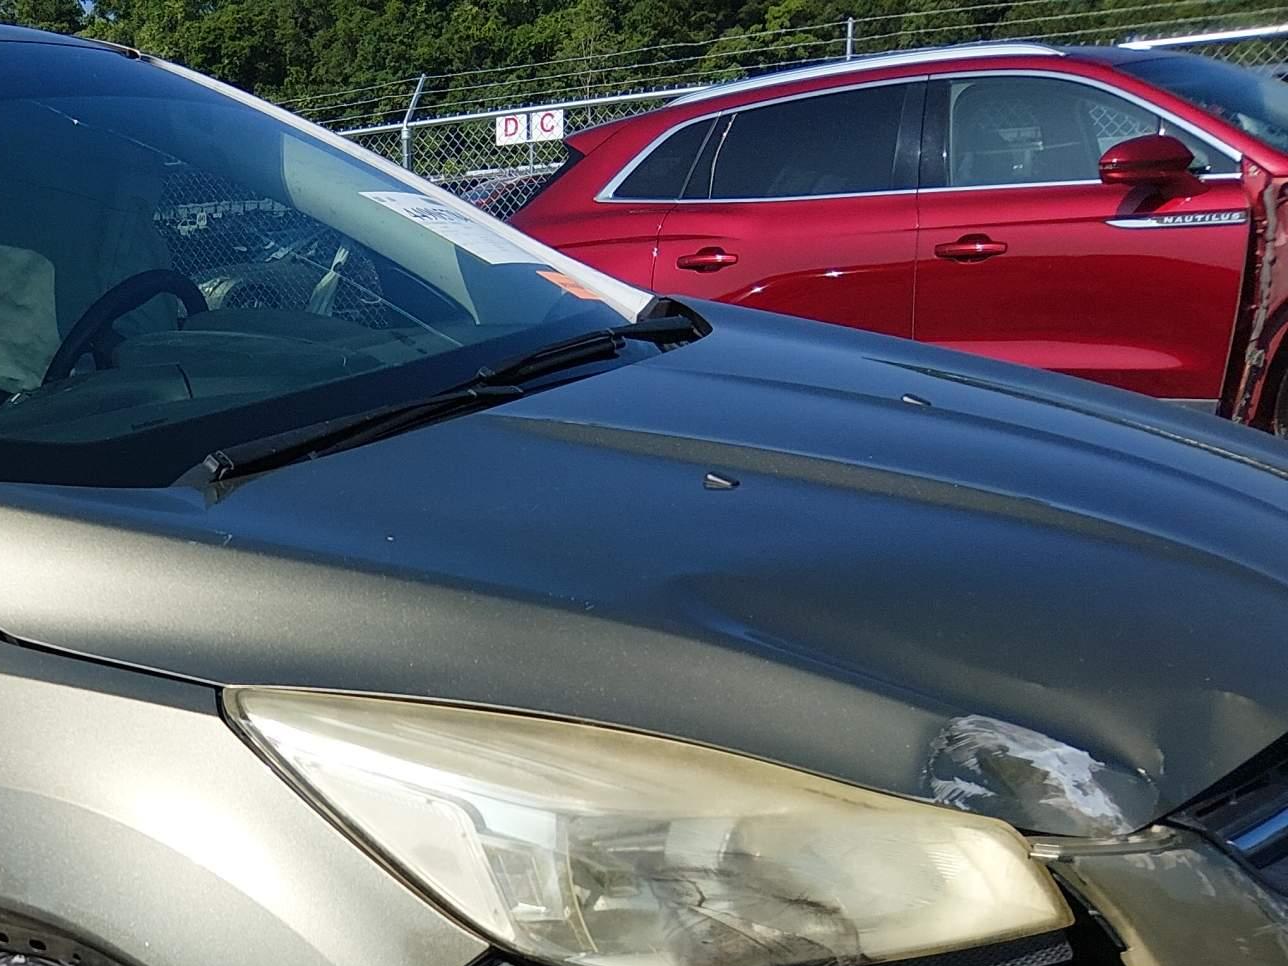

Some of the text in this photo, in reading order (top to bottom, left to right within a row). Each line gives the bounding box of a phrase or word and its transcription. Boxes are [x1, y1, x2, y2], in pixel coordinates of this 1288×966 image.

[504, 117, 519, 137] D
[540, 112, 555, 133] C
[1163, 212, 1241, 224] NAUTILUS
